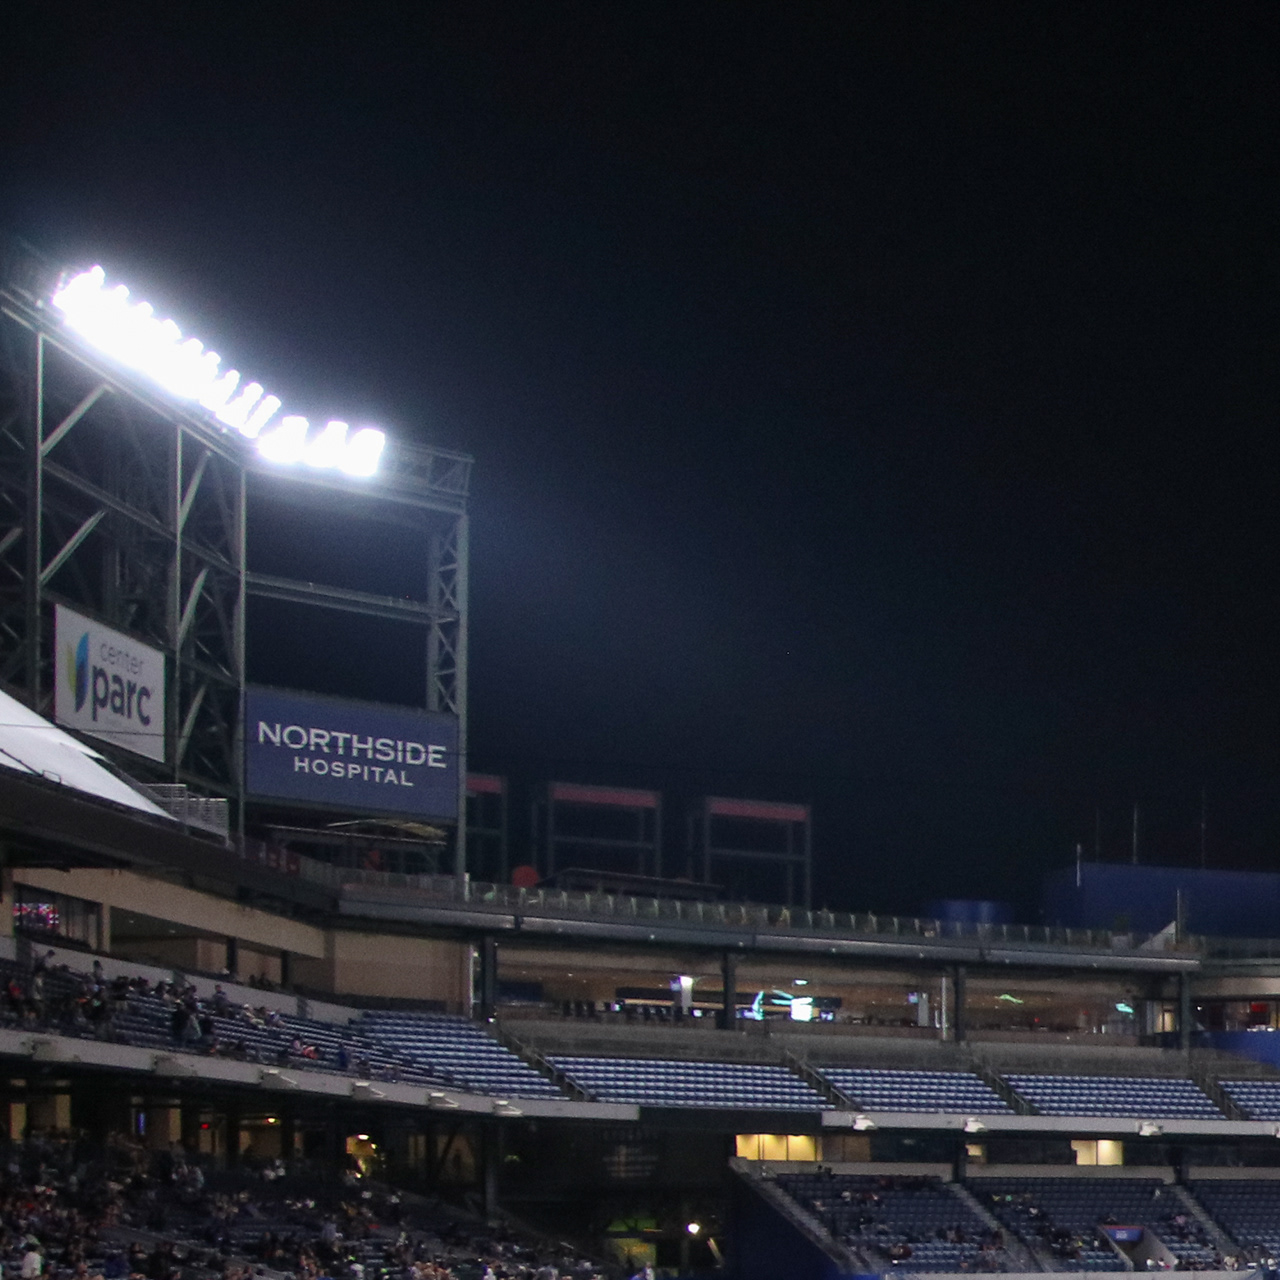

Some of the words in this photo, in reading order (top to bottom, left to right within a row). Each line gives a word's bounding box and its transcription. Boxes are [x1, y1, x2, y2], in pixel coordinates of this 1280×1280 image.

[100, 643, 143, 674] center
[92, 665, 151, 726] parc
[258, 720, 447, 768] NORTHSIDE
[294, 757, 415, 787] HOSPITAL
